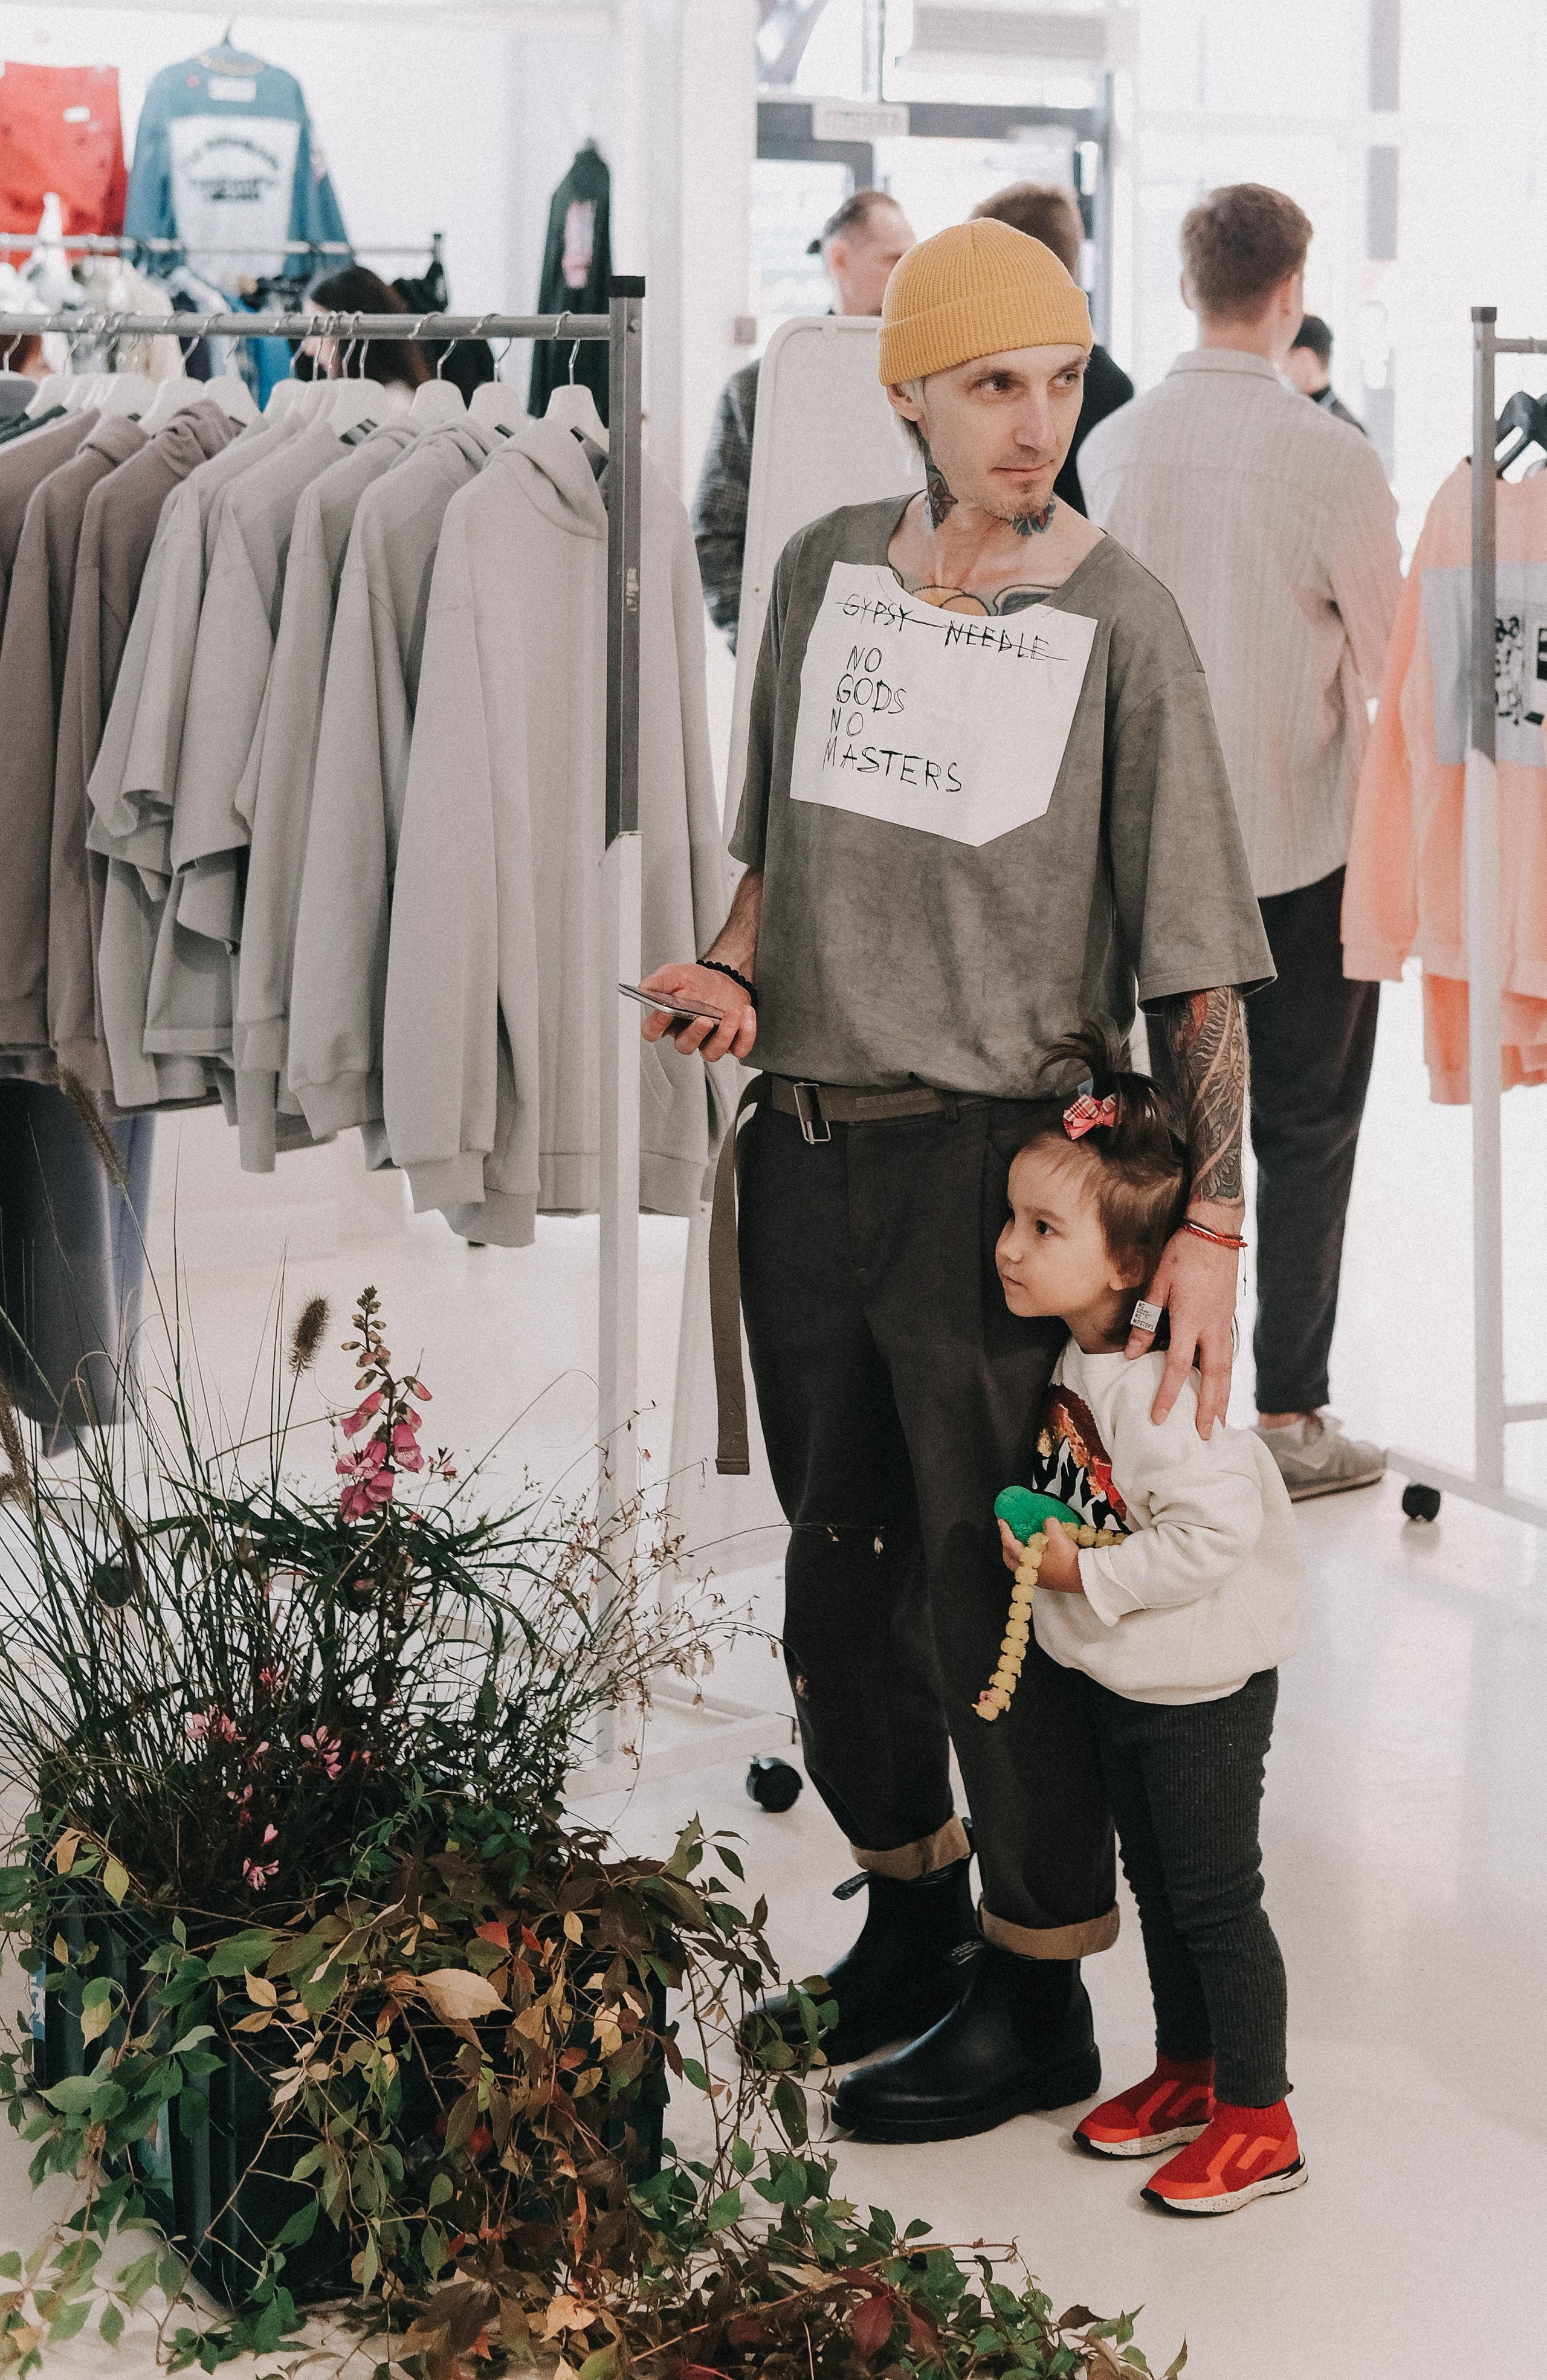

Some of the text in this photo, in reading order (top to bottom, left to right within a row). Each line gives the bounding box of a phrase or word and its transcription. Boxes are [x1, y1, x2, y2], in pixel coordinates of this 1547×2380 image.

[842, 594, 1050, 660] GYPSY NEEDLE
[847, 645, 882, 672] NO
[836, 673, 906, 714] GODS
[830, 707, 864, 737] NO
[822, 735, 962, 792] MASTERS
